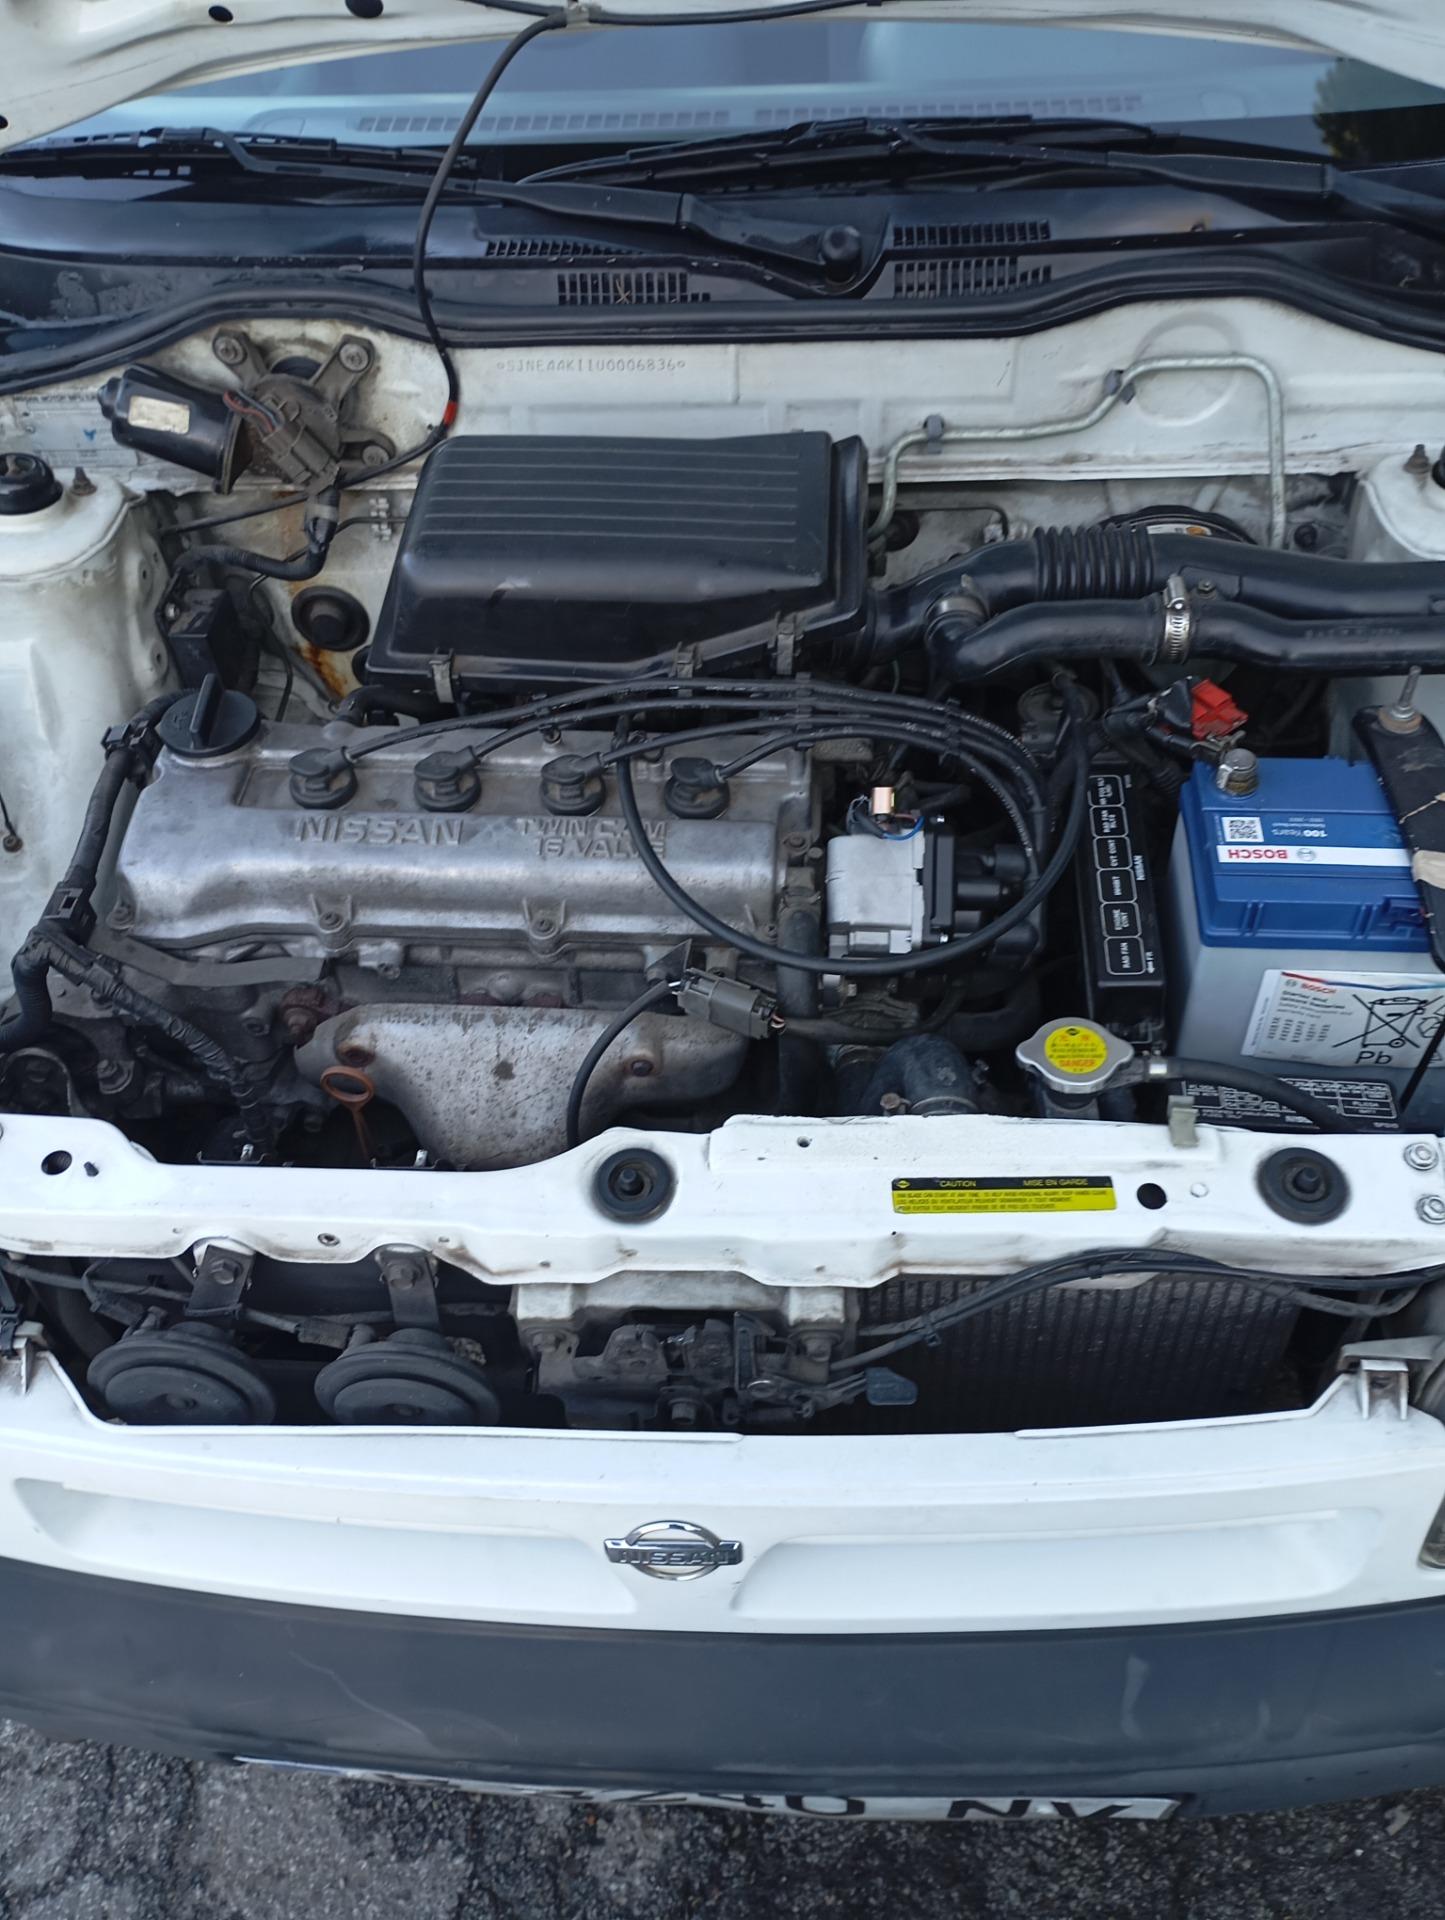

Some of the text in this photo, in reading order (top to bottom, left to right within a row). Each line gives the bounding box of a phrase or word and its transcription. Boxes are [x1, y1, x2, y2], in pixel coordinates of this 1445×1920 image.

[294, 815, 464, 845] NISSAN
[516, 817, 591, 837] TWIN
[1303, 829, 1328, 838] 100
[535, 837, 566, 858] 16
[1227, 849, 1288, 859] BOSCH
[1120, 942, 1131, 969] RAD FAN
[1300, 983, 1336, 994] BOSCH
[1355, 1050, 1392, 1065] Pb
[939, 1180, 977, 1188] CAUTION
